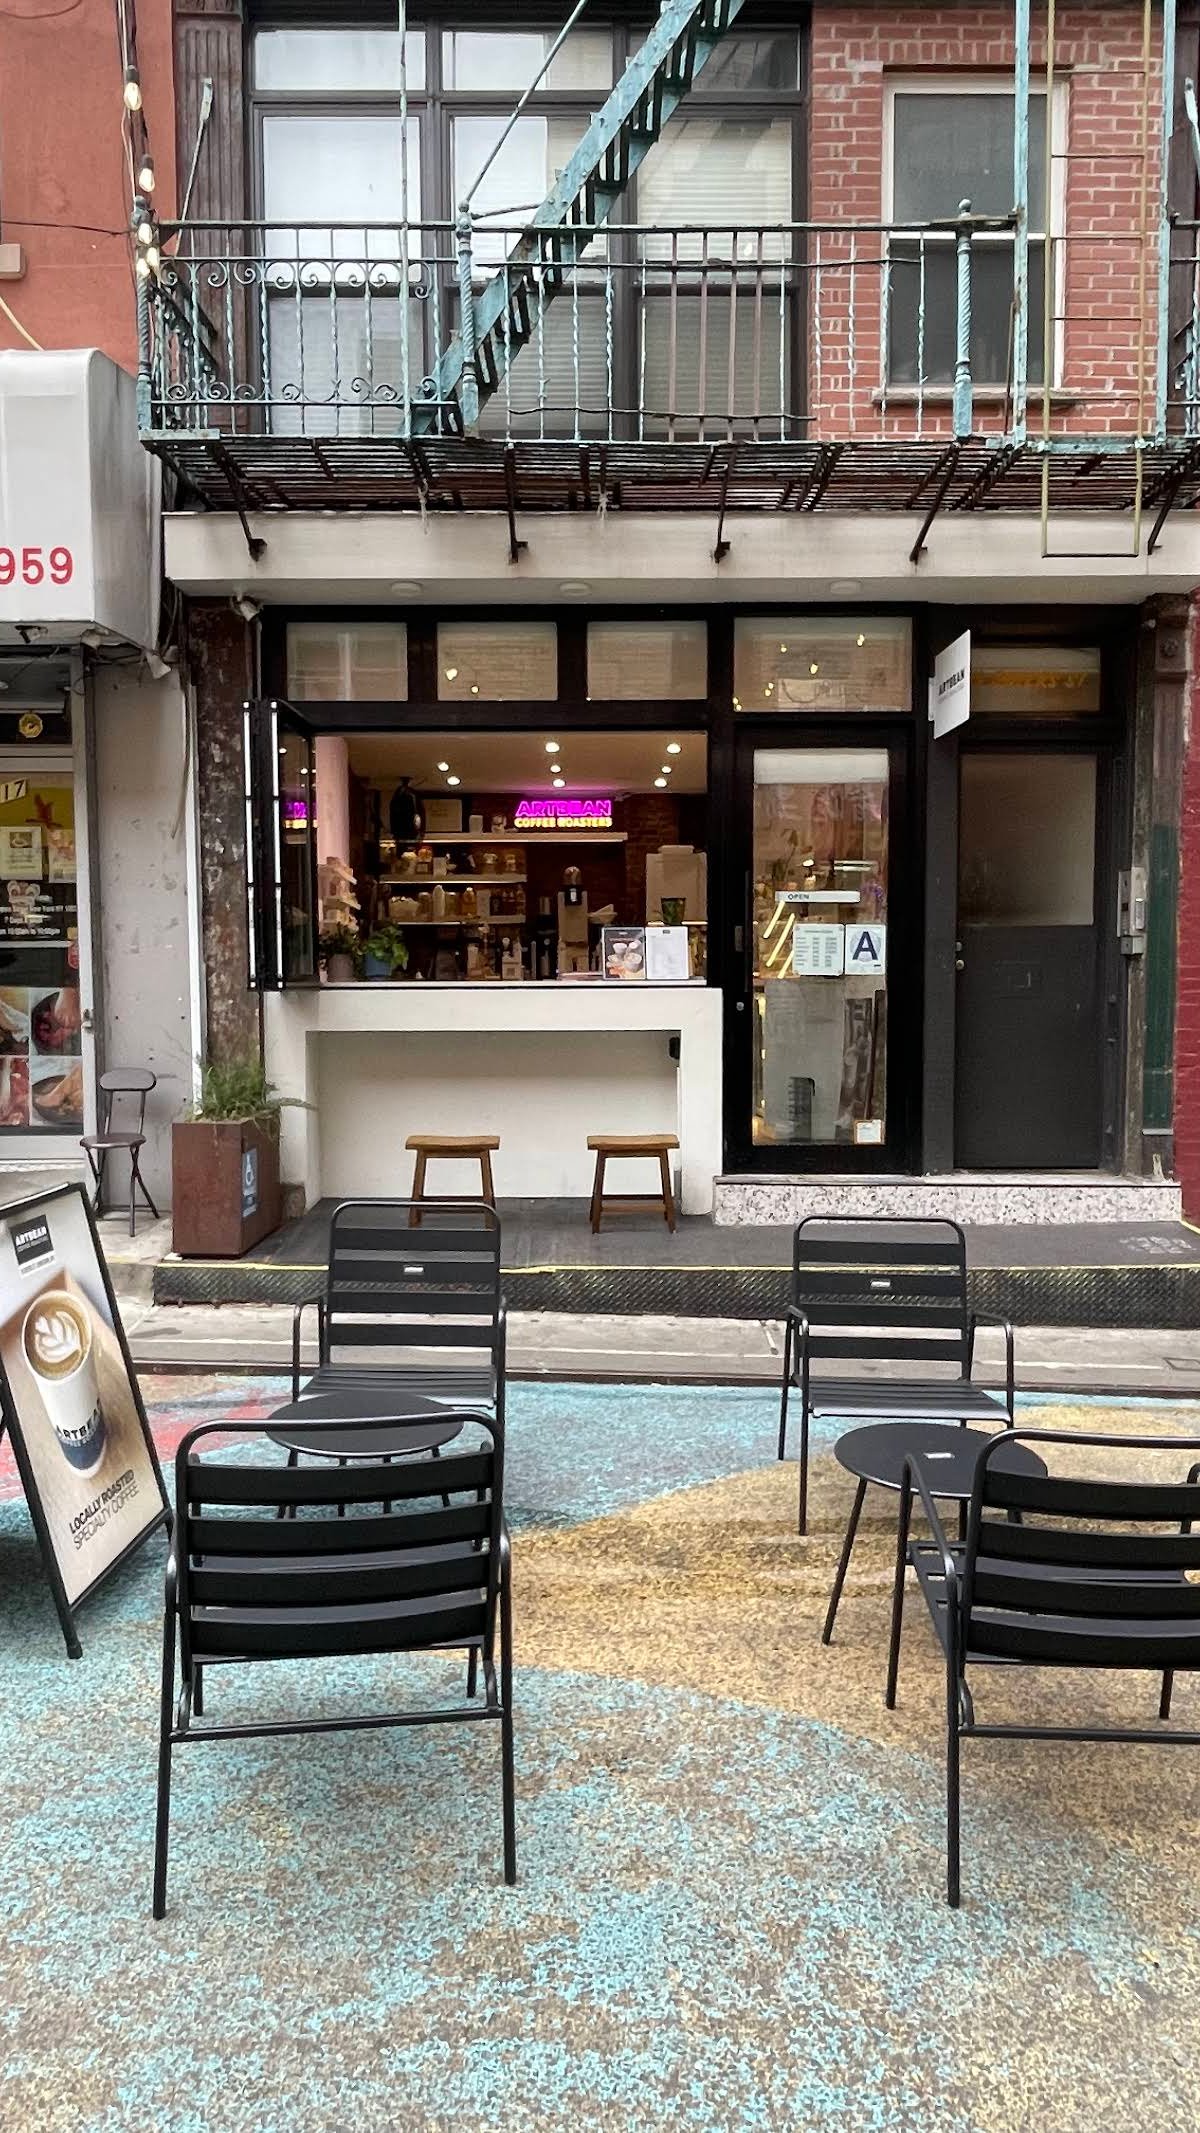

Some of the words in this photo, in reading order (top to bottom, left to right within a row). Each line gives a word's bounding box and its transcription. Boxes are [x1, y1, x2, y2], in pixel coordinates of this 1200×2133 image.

[0, 547, 73, 585] 959
[514, 817, 556, 828] COFFEE
[557, 817, 613, 828] ROASTERS
[515, 799, 612, 817] ARTBEAN
[852, 931, 879, 961] A
[69, 1497, 103, 1534] LOCALLY
[101, 1469, 135, 1503] ROASTED
[73, 1507, 113, 1550] SPECIALTY
[111, 1480, 140, 1513] COFFEE
